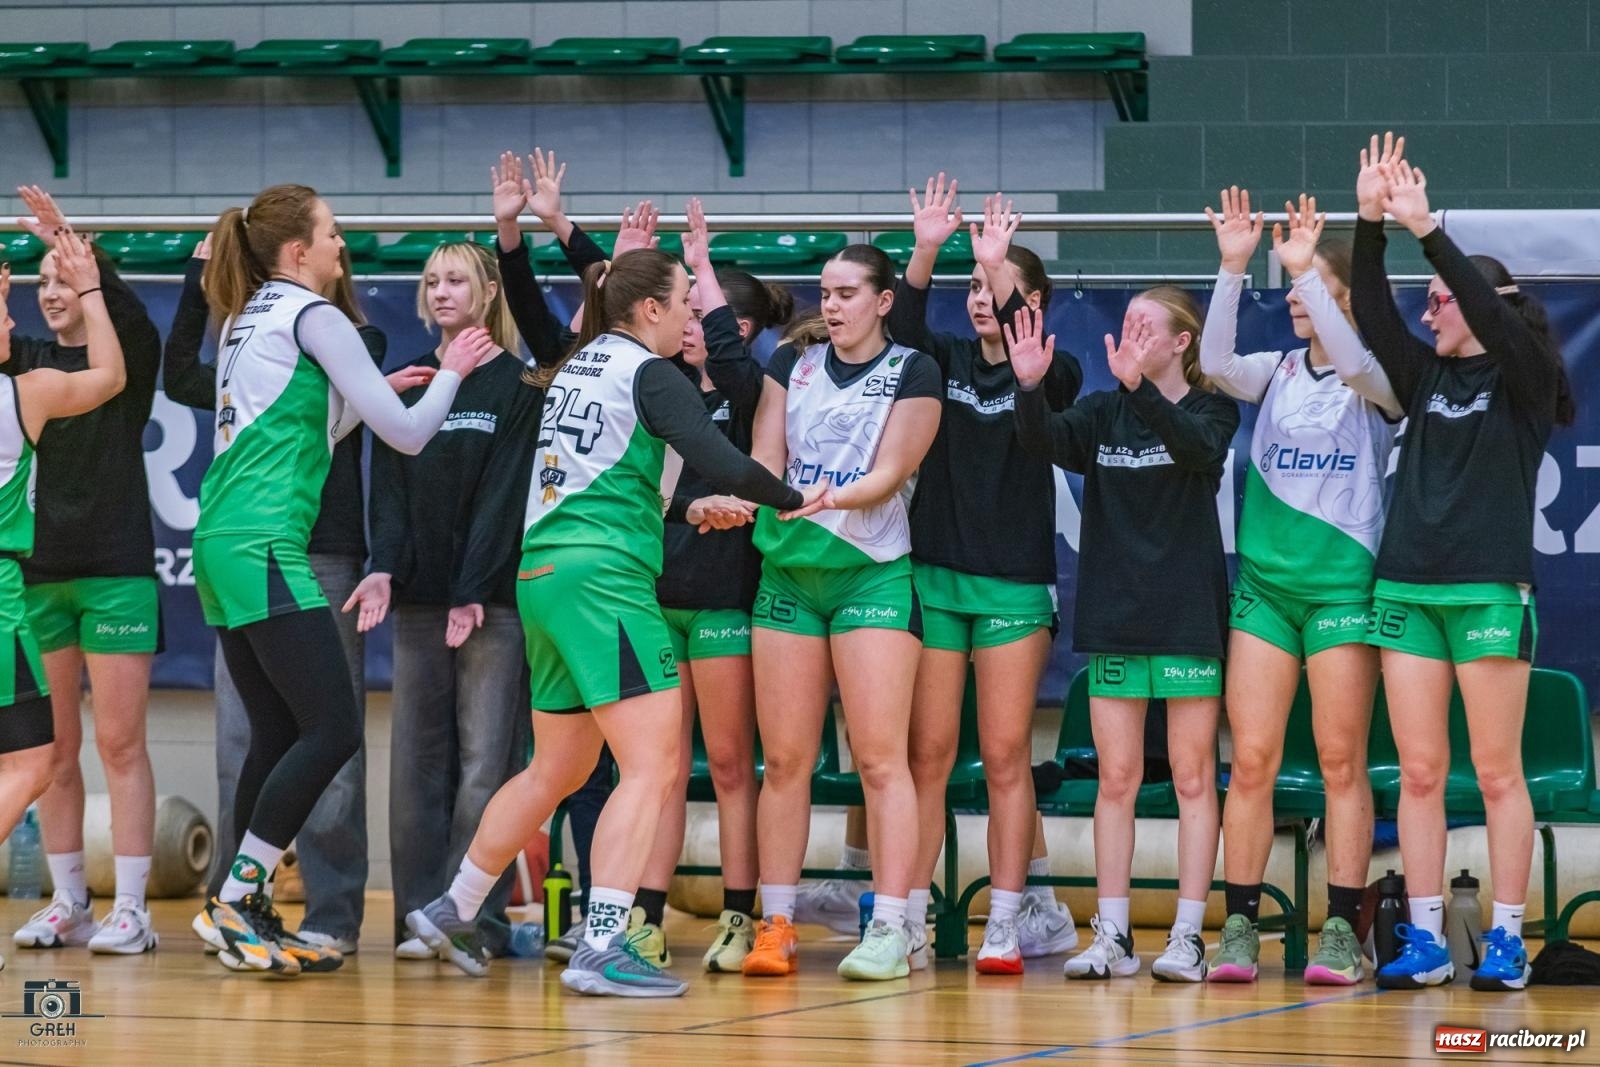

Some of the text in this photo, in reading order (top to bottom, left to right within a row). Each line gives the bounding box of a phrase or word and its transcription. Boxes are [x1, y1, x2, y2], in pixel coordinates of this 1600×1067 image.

[221, 325, 257, 389] 7
[591, 352, 611, 363] AZS
[447, 411, 498, 423] RACIBÓRZ
[535, 385, 604, 456] 24
[1276, 447, 1357, 471] Clavis
[753, 591, 799, 624] 25
[1095, 655, 1126, 685] 15
